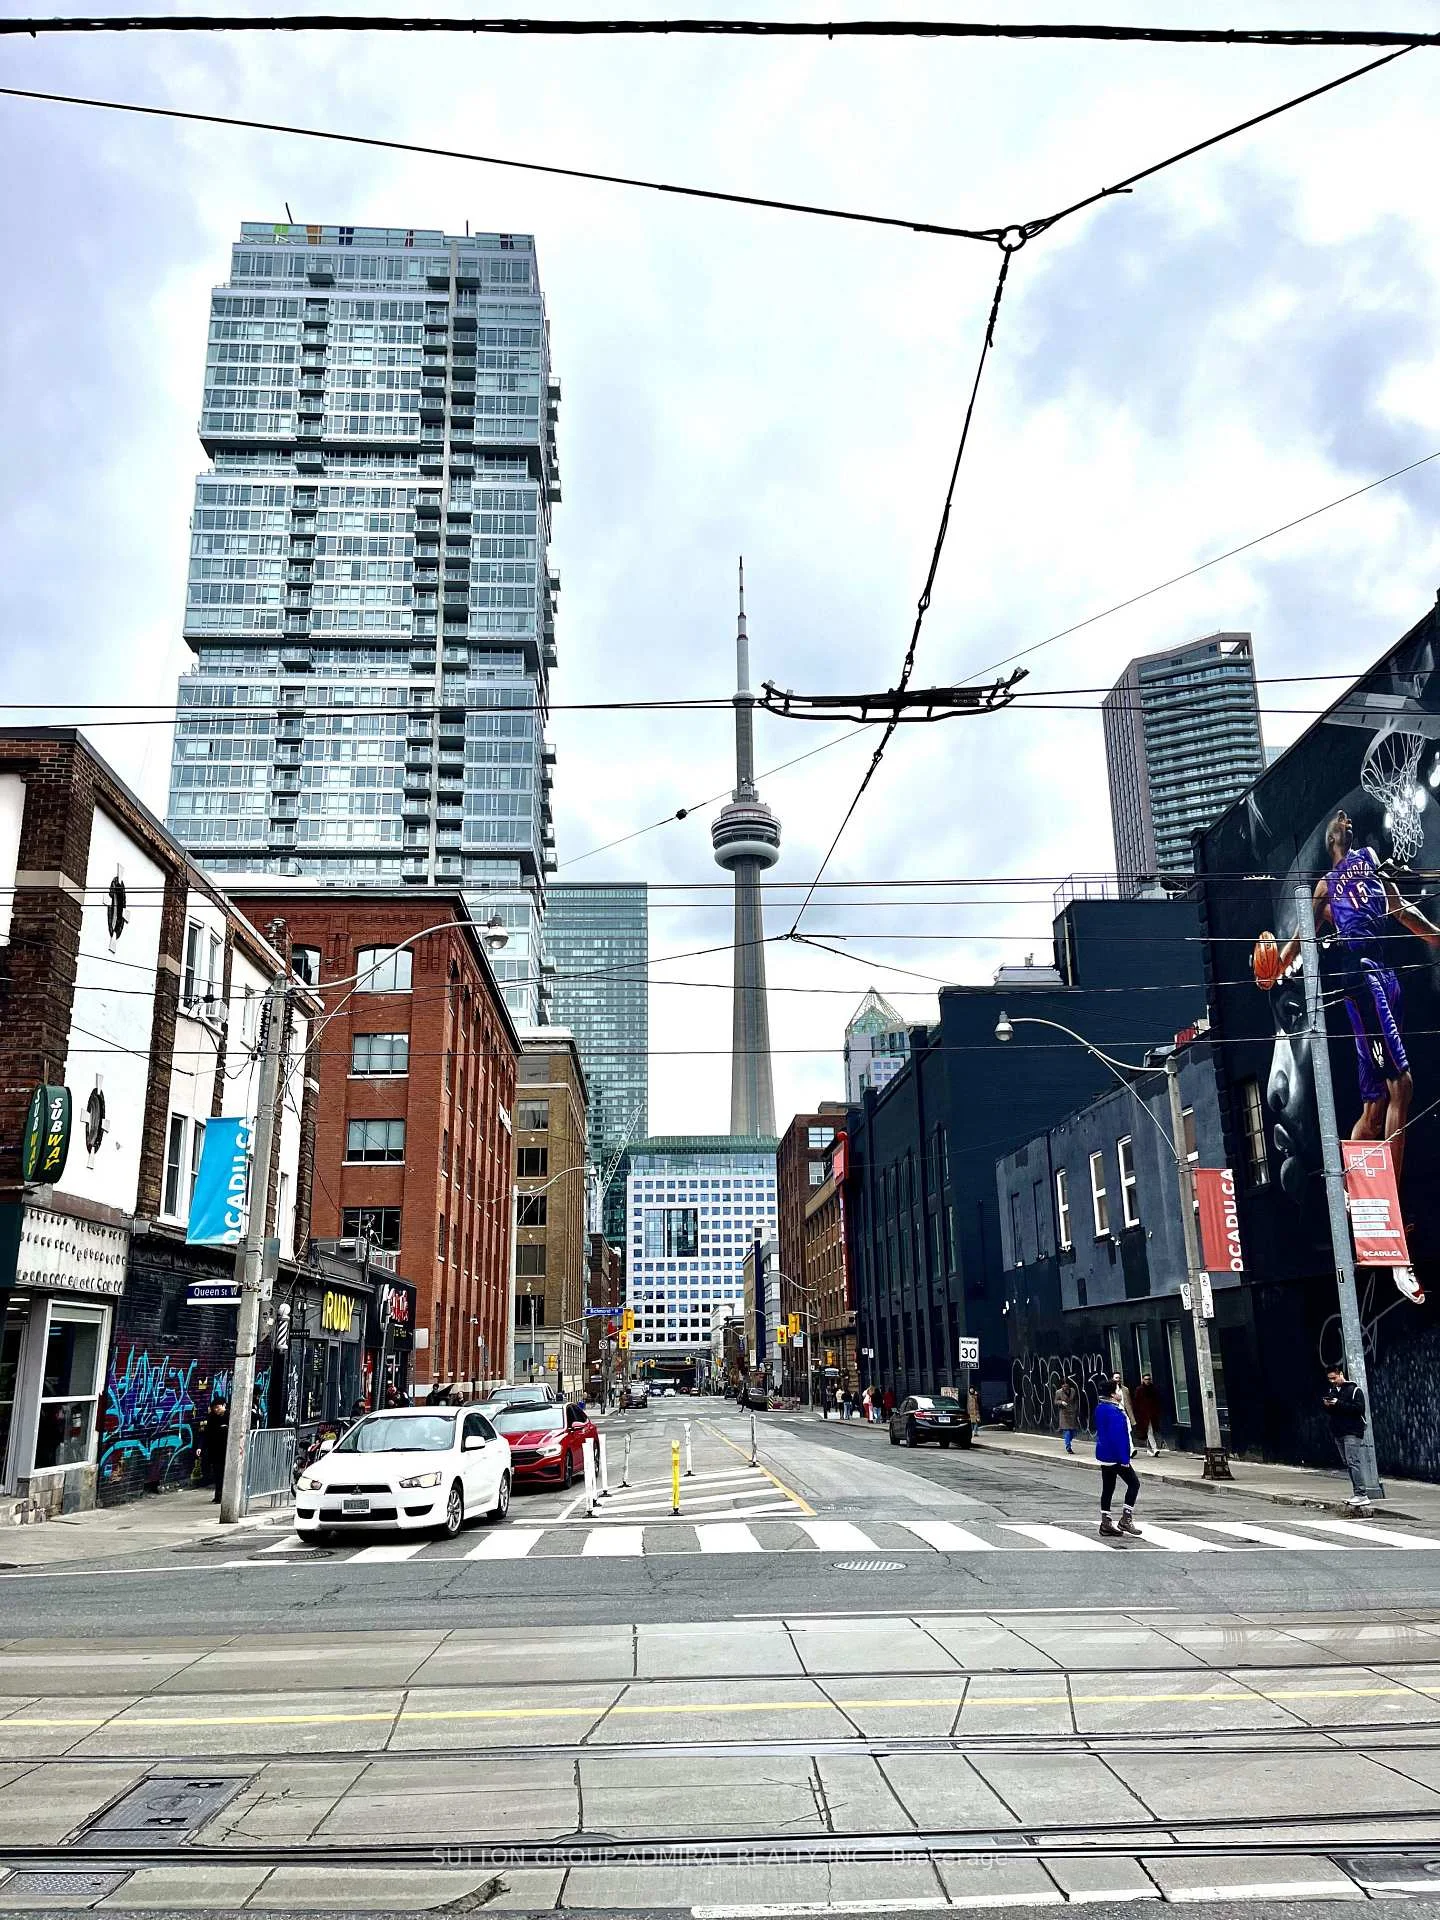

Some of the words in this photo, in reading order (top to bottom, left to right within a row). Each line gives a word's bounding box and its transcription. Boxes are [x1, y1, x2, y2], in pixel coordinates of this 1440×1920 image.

[1333, 861, 1370, 901] TORONTO
[1348, 881, 1369, 909] 15
[27, 1087, 41, 1175] SUBWAY
[43, 1097, 64, 1170] SUBWAY
[1220, 1168, 1244, 1271] OCADU.CA
[194, 1287, 219, 1296] Queen
[230, 1287, 238, 1296] W
[324, 1290, 355, 1333] RUDY
[961, 1347, 977, 1359] 30
